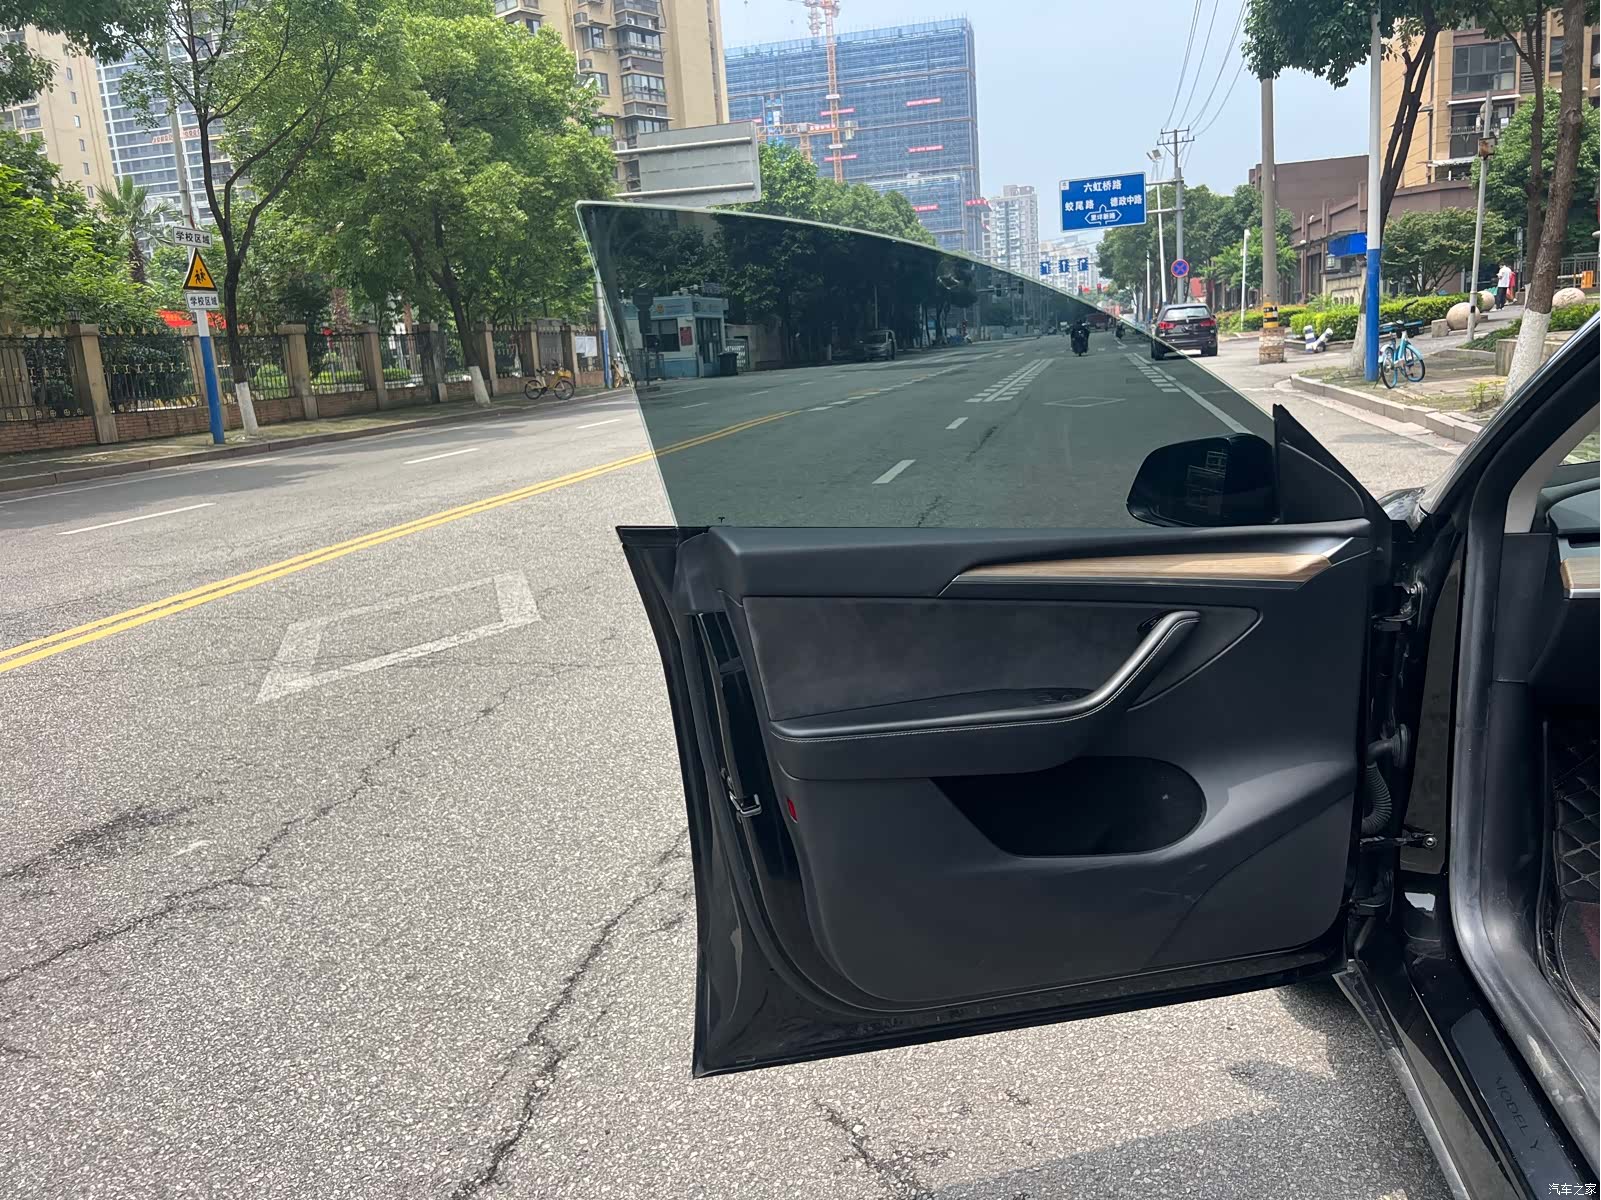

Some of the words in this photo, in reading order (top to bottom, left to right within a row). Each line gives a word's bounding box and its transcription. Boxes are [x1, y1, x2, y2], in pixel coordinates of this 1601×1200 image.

[1083, 180, 1121, 193] 六虹桥路
[1110, 194, 1142, 207] 德政中路
[175, 231, 211, 245] 学校区域
[190, 296, 218, 306] 学校区域
[1529, 1138, 1544, 1152] Y
